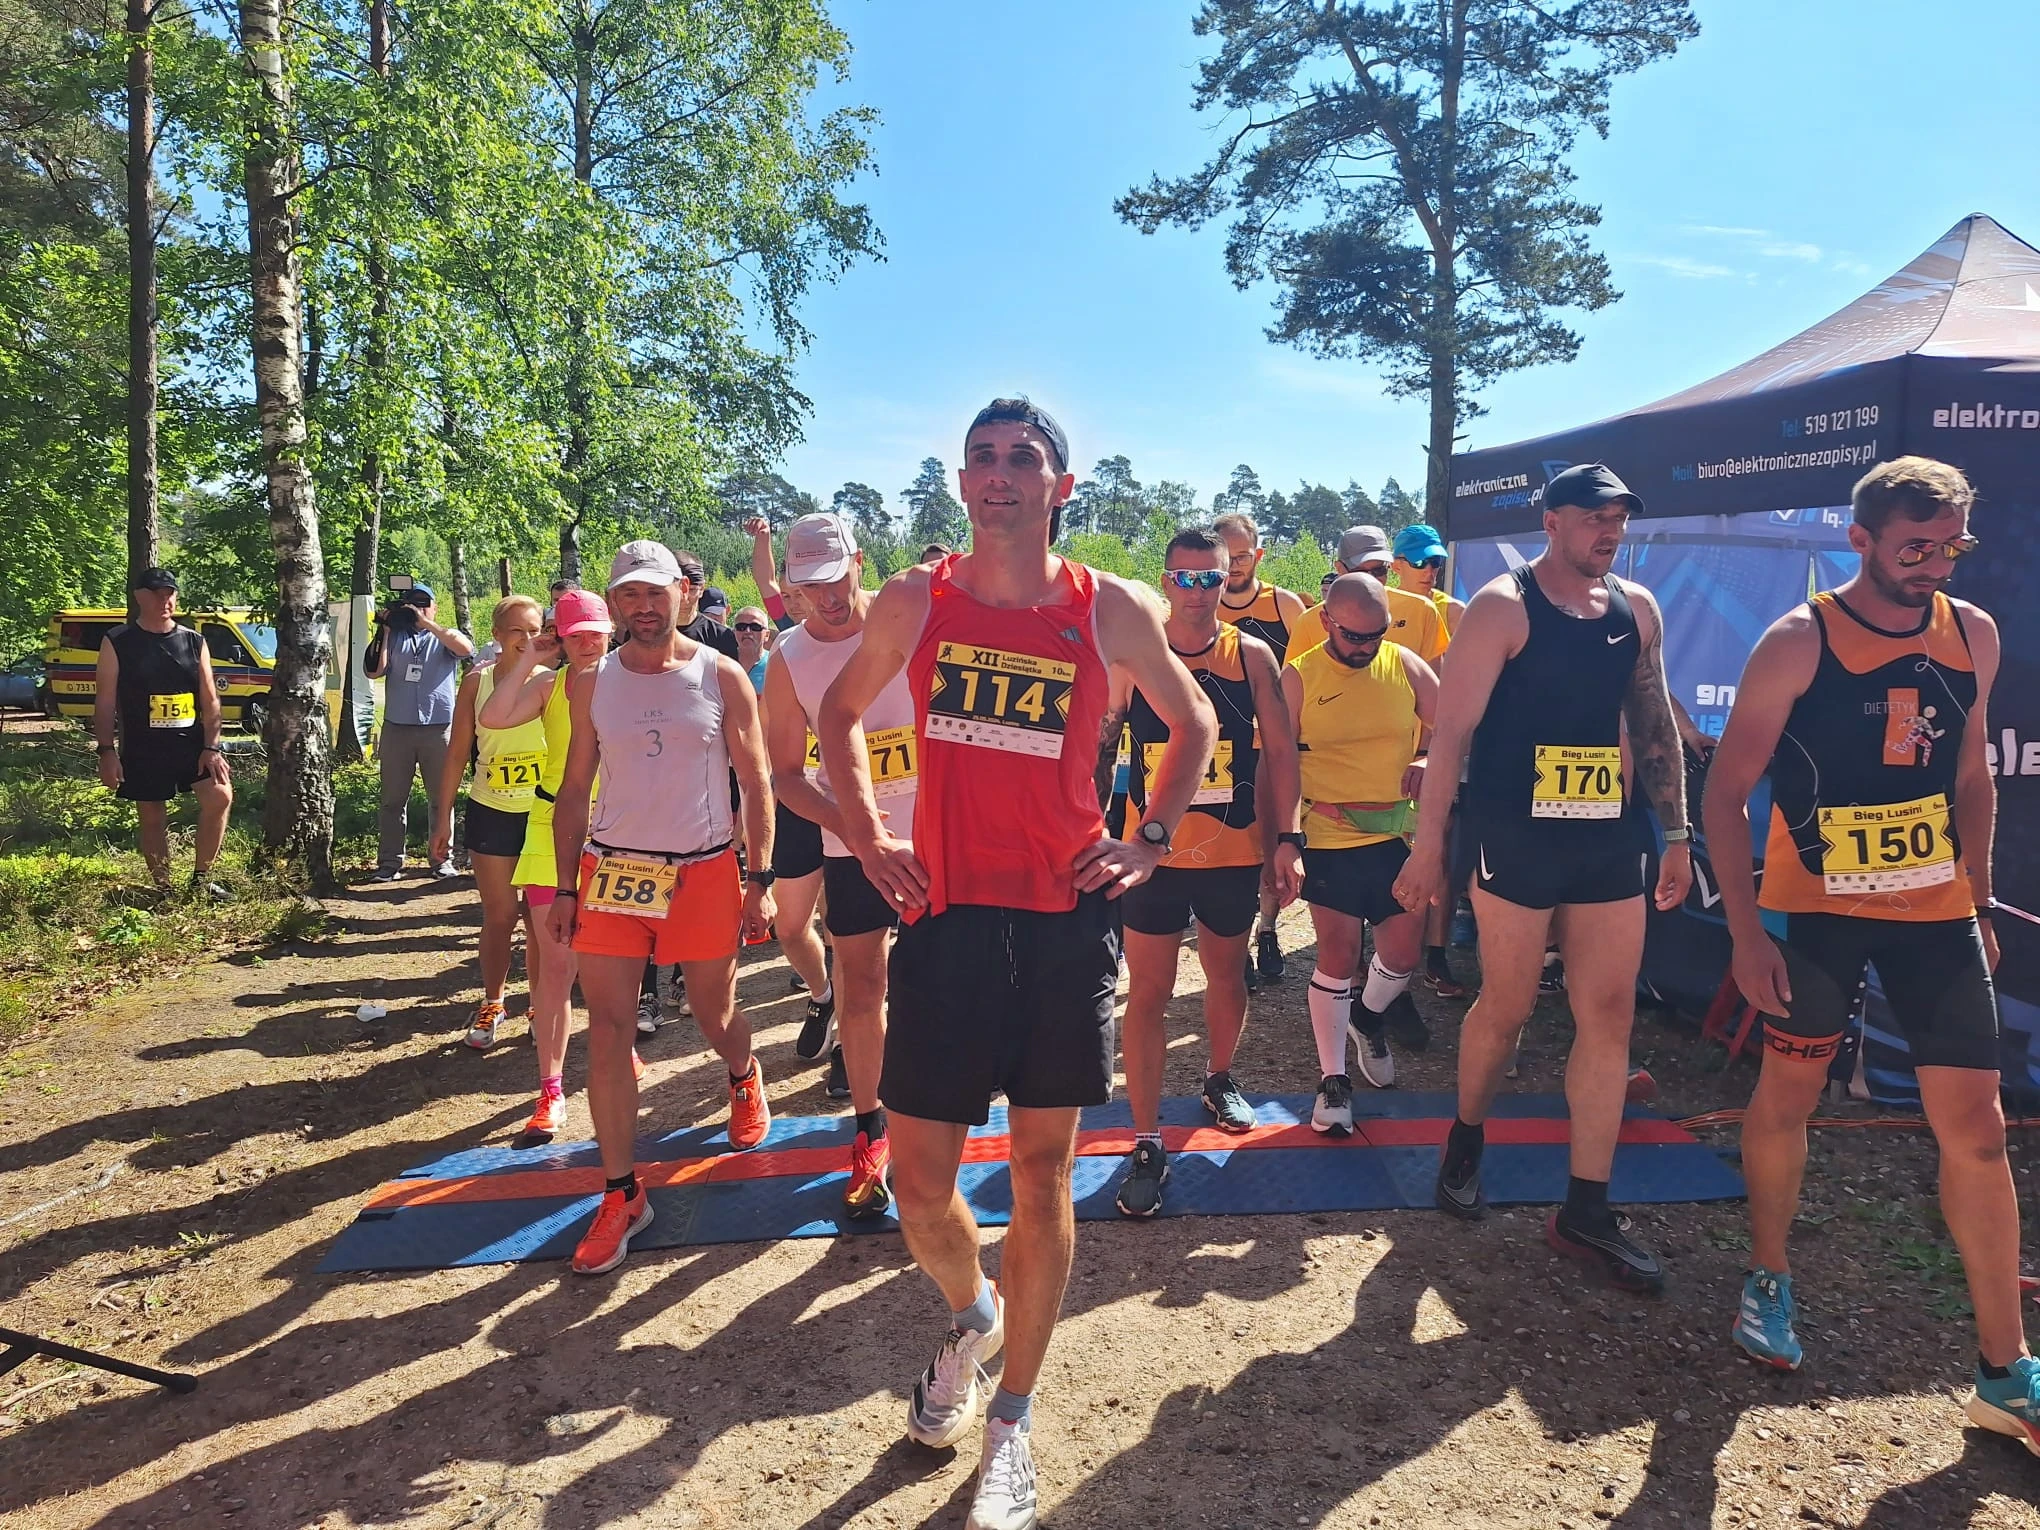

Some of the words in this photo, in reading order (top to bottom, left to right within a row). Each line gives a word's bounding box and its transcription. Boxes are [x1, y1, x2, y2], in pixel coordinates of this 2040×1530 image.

[1805, 414, 1827, 435] 519
[1831, 410, 1851, 431] 121
[1855, 405, 1879, 427] 199
[1933, 402, 2040, 428] elektro
[1698, 440, 1877, 480] biuro@elektronicznezapisy.pl
[1455, 473, 1529, 498] elektroniczne
[971, 650, 1000, 667] XII
[960, 670, 1046, 723] 114
[160, 703, 189, 717] 154
[645, 729, 663, 758] 3
[877, 731, 903, 743] Lusini
[872, 744, 911, 776] 71
[1561, 750, 1582, 760] Bieg
[499, 763, 541, 785] 121
[1555, 765, 1611, 795] 170
[1853, 810, 1883, 821] Bieg
[1887, 804, 1923, 818] Lusini
[1848, 821, 1935, 865] 150
[605, 860, 625, 870] Bieg
[627, 863, 654, 874] Lusini
[596, 873, 657, 905] 158
